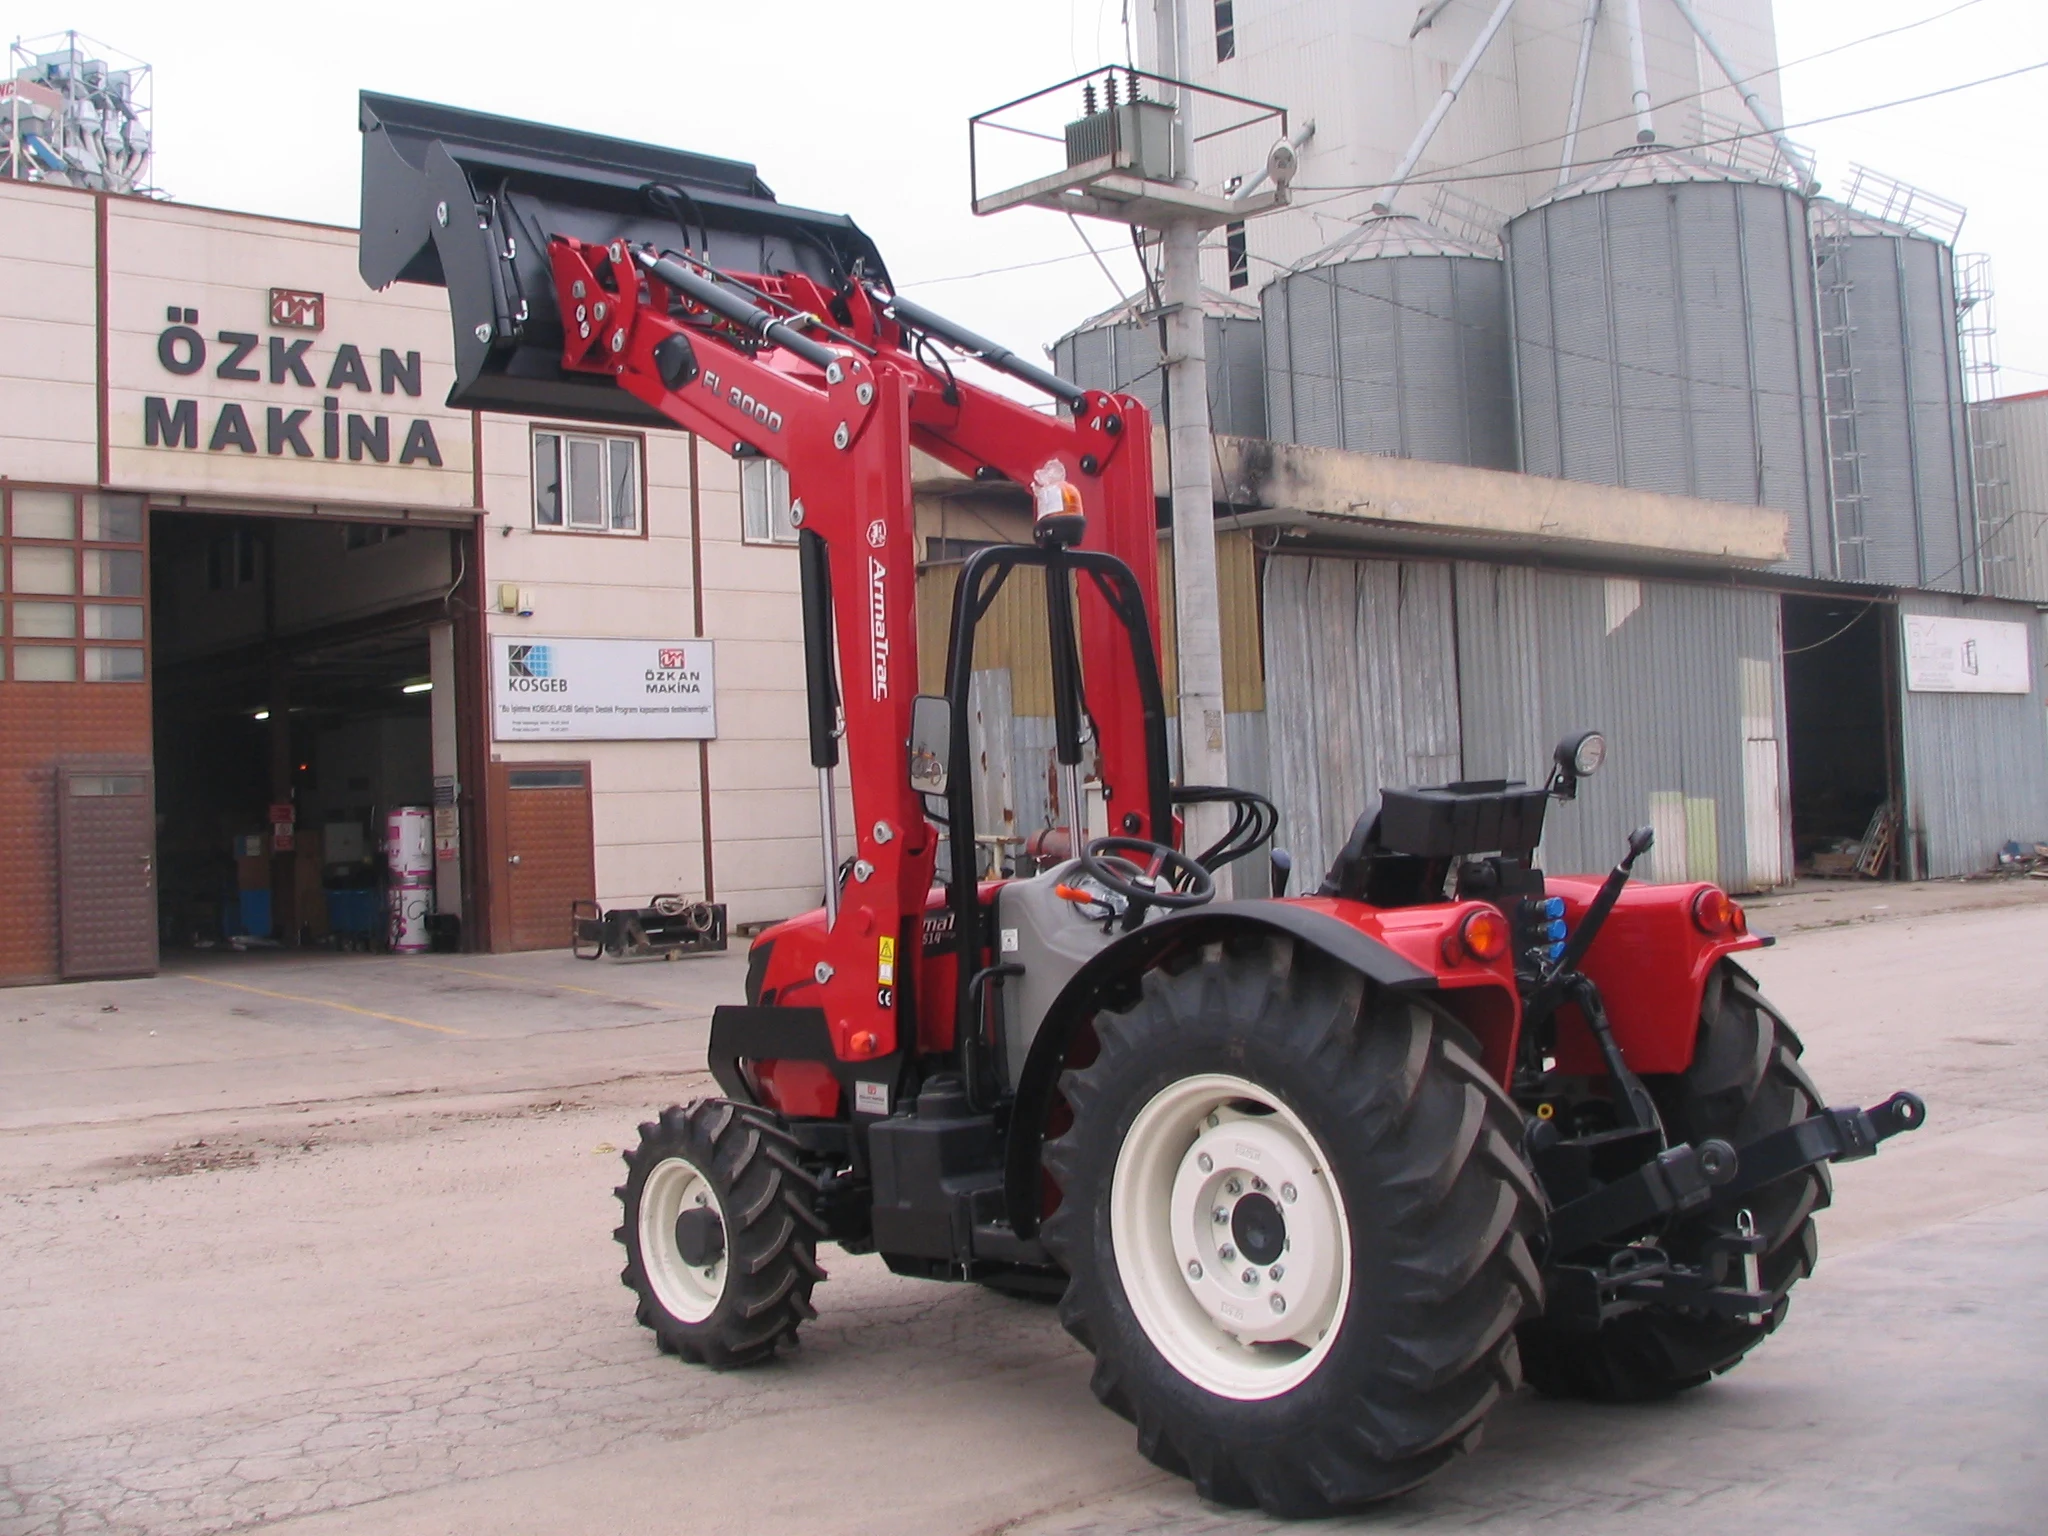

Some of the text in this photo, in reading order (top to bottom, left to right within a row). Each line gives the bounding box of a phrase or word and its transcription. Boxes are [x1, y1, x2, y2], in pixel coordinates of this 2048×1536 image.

[157, 306, 422, 397] ÖZKAN
[702, 369, 783, 433] FL 3000
[144, 396, 443, 467] MAKİNA
[509, 678, 568, 692] KOSGEB
[645, 669, 700, 681] ÖZKAN
[645, 682, 700, 693] MAKİNA
